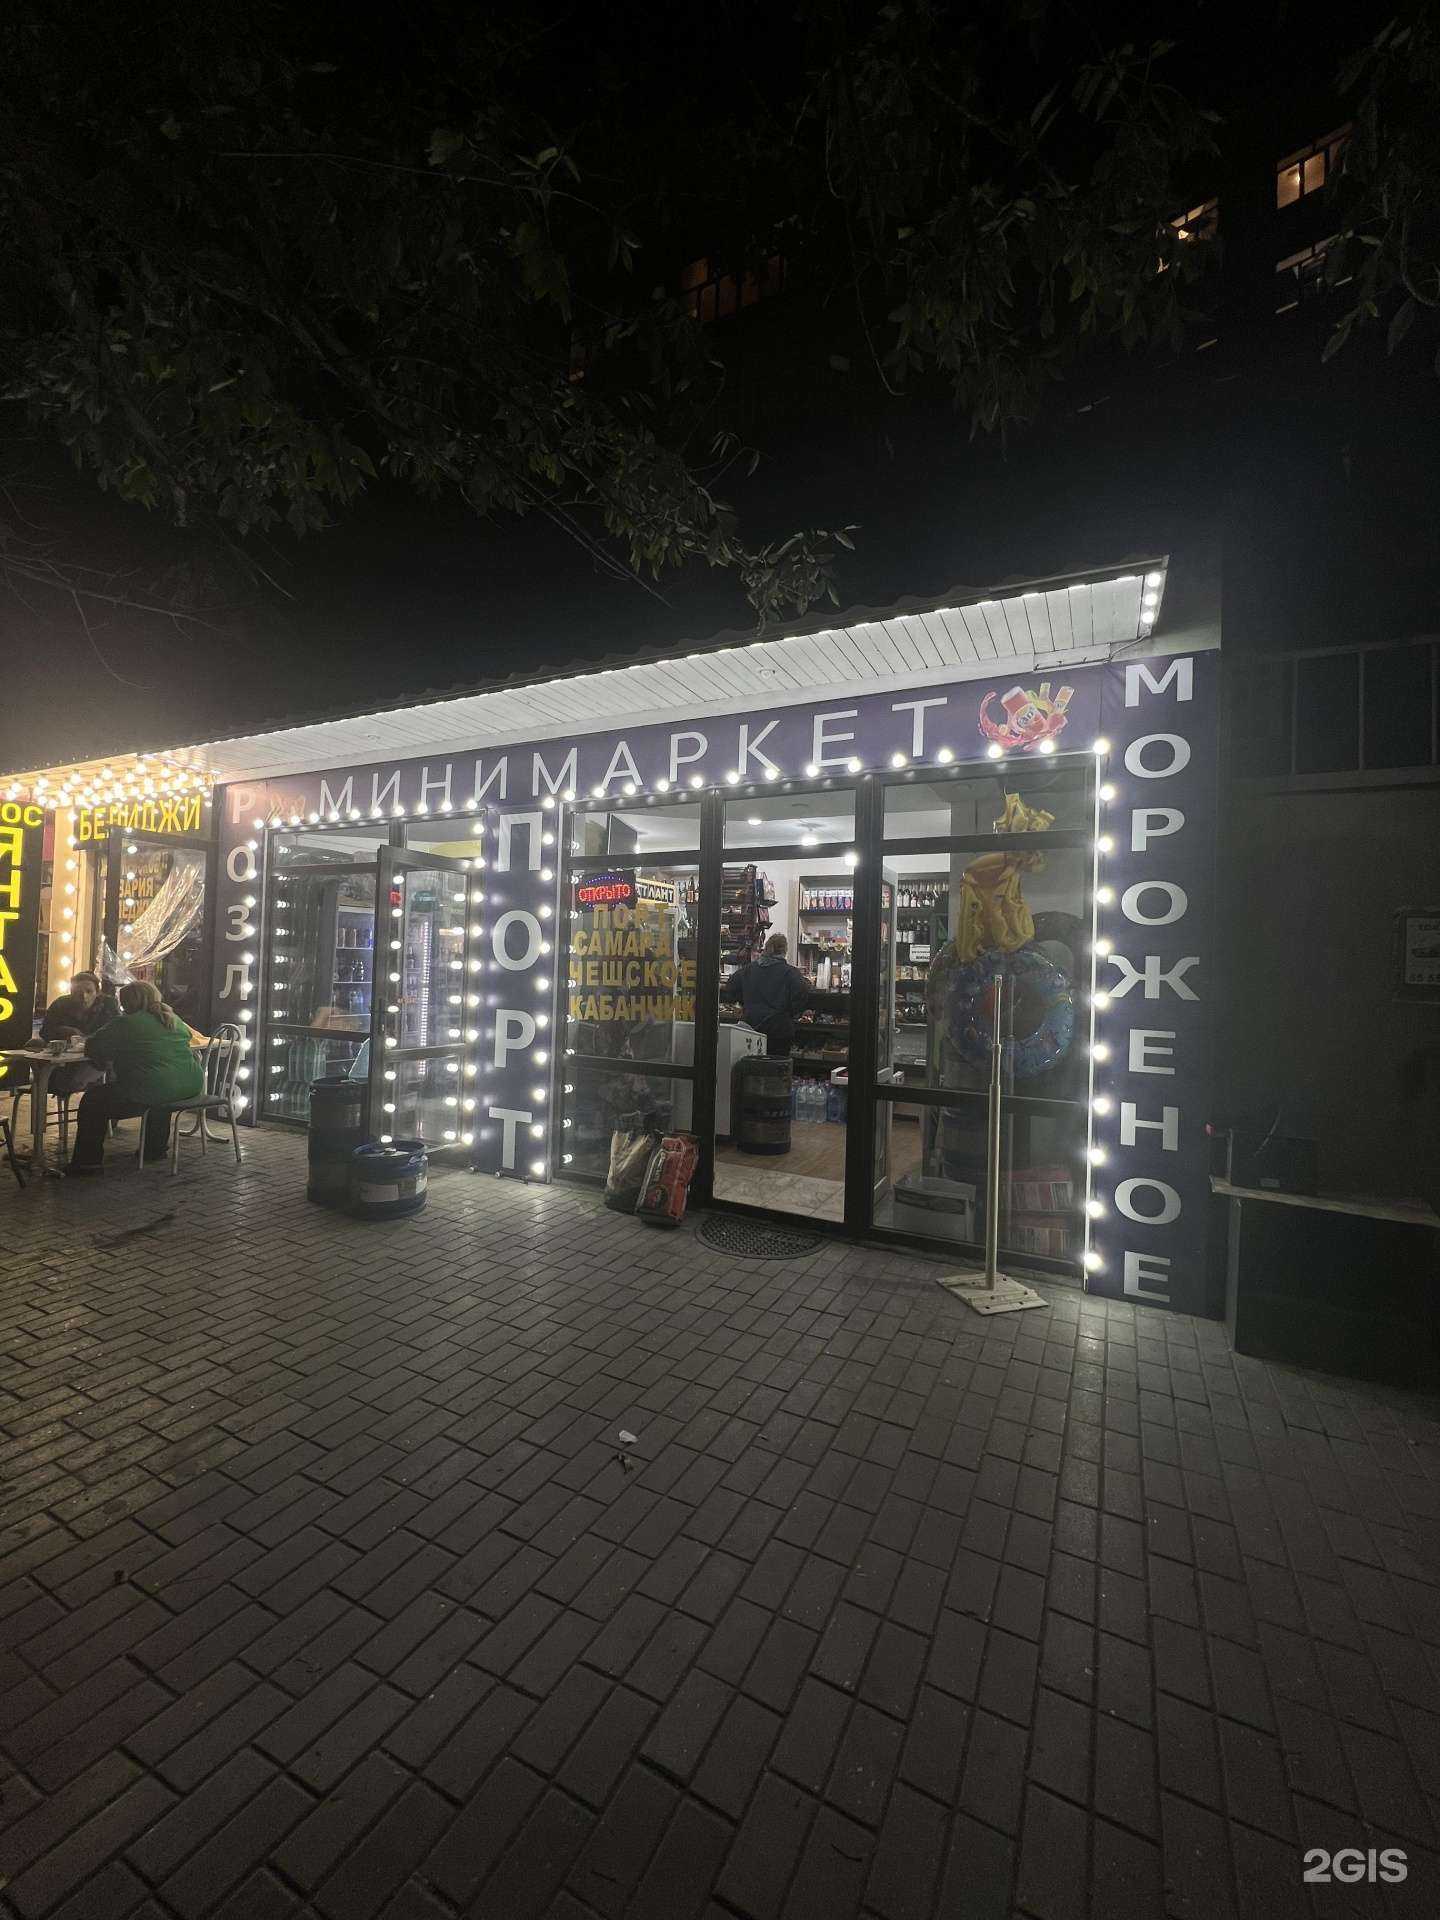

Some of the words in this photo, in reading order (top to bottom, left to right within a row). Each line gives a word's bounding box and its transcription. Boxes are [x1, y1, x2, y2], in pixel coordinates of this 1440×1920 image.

[319, 697, 947, 817] МИНИМАРКЕТ
[578, 884, 631, 902] ОТКРЫТО
[594, 903, 669, 928] ПОРТ
[573, 931, 671, 957] САМАРА
[569, 960, 696, 987] ЧЕШСКОЕ
[1107, 656, 1200, 1302] МОРОЖЕНОЕ
[488, 811, 543, 1169] ПОРТ
